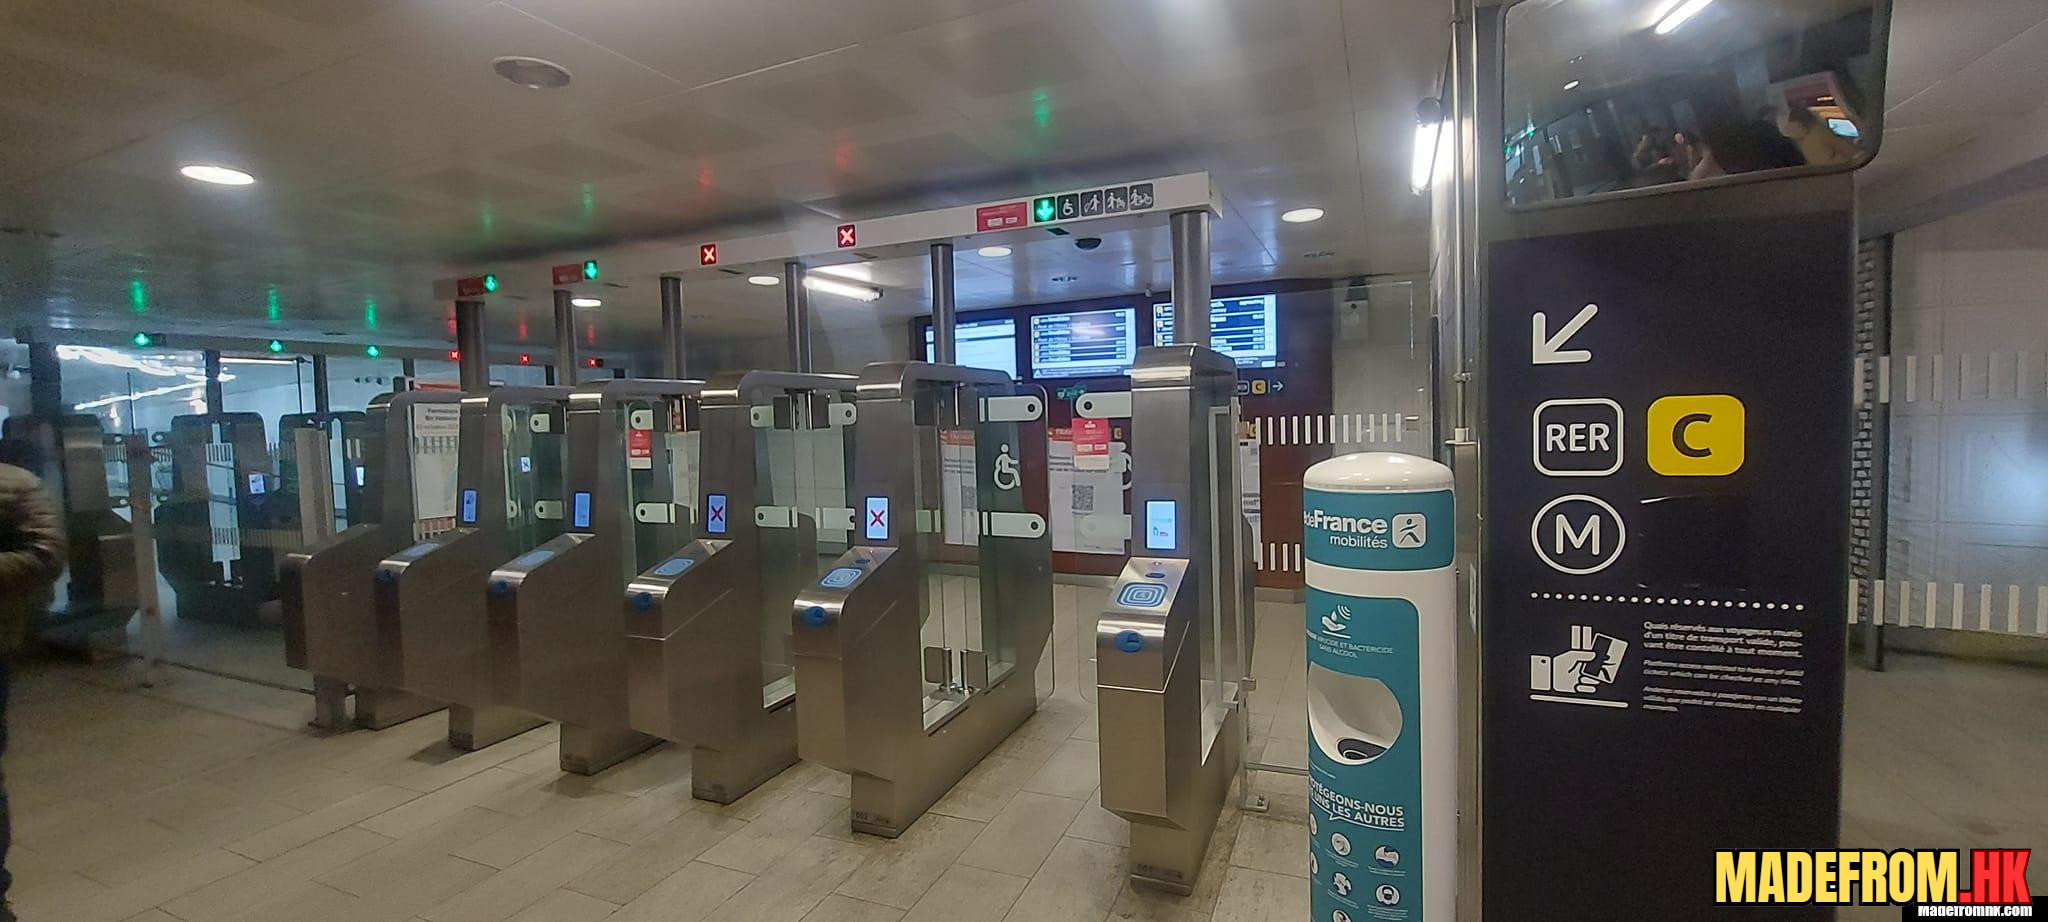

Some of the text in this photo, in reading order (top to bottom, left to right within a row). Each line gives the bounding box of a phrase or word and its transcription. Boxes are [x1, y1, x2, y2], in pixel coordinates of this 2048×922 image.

[1546, 413, 1712, 458] RER C
[1330, 535, 1388, 549] mobilités
[1556, 514, 1600, 555] M
[1643, 621, 1669, 630] Quais
[1332, 802, 1351, 819] LES
[1354, 811, 1405, 828] AUTRES
